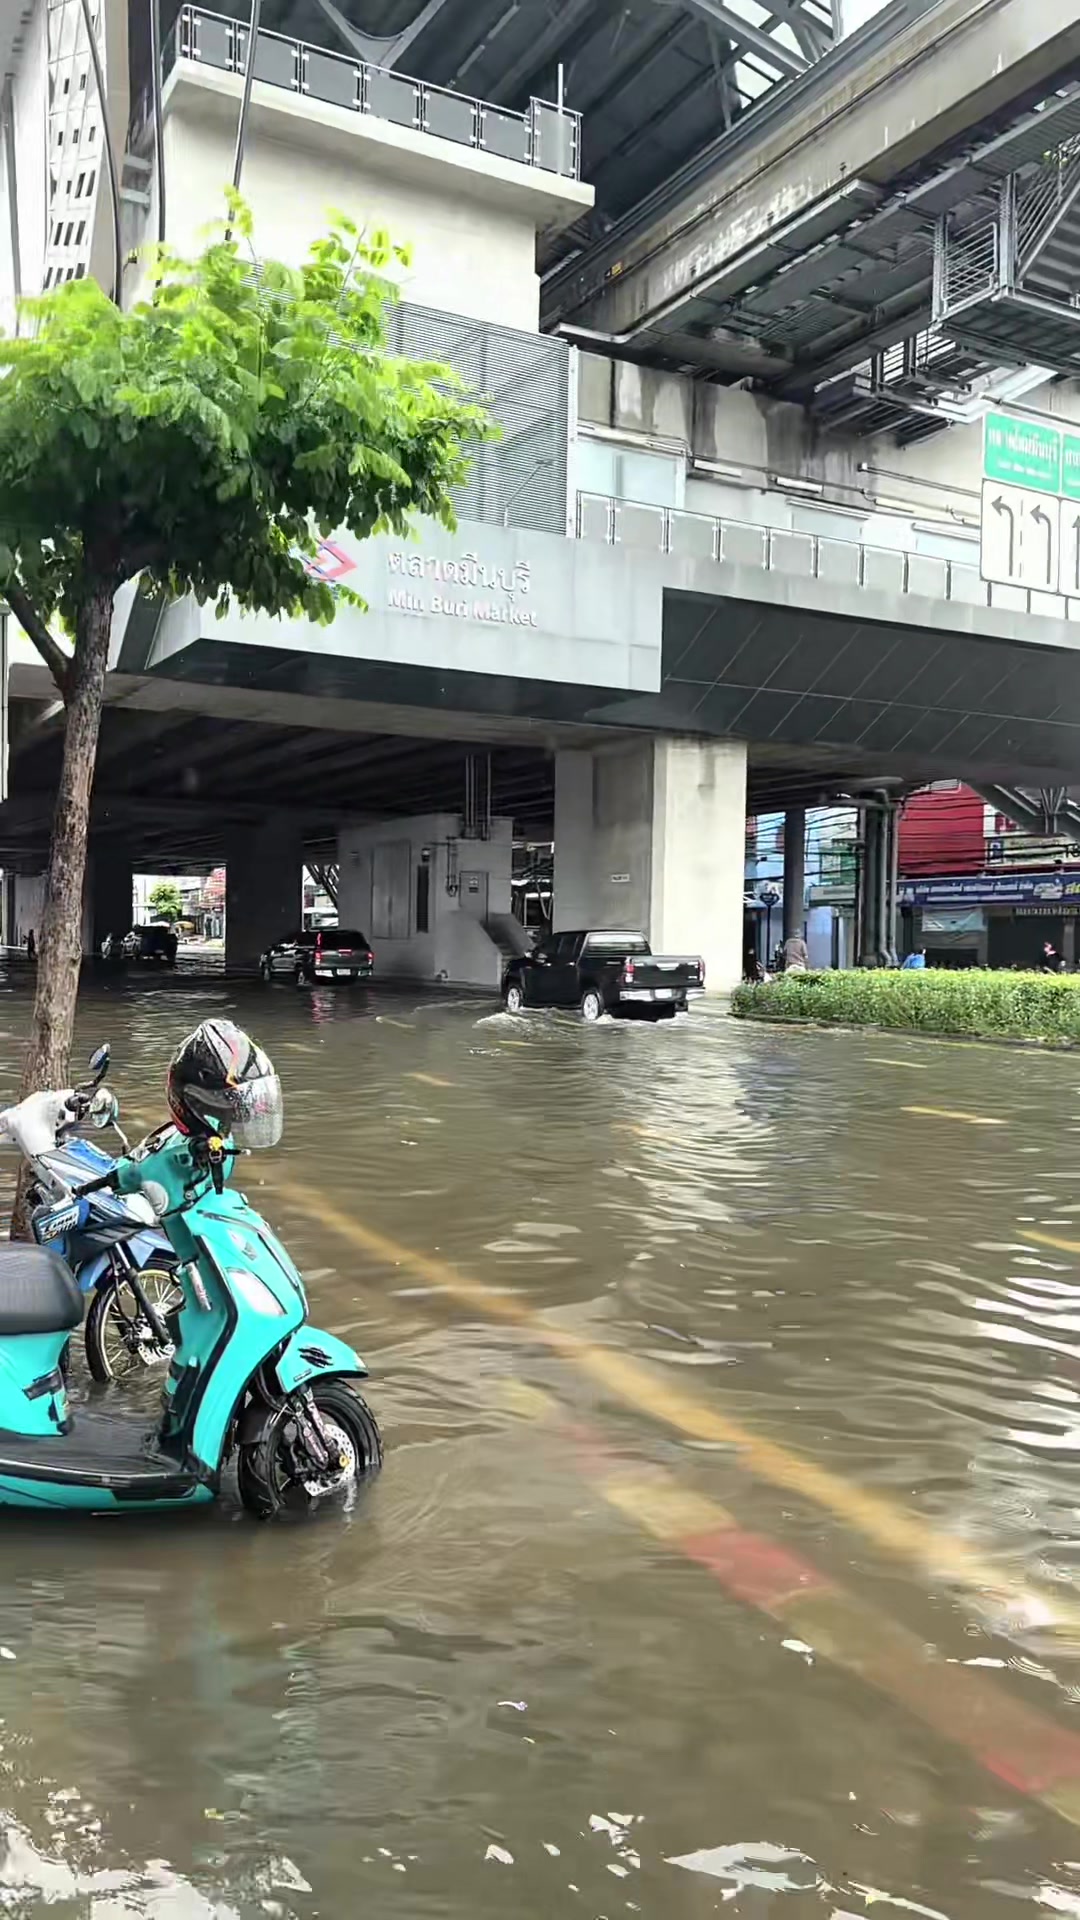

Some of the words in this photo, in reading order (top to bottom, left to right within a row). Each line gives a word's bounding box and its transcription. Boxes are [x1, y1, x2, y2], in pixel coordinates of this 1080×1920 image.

[388, 551, 531, 603] ตลาดมีนบุรี
[387, 589, 424, 612] Min
[430, 595, 468, 618] Buri
[472, 600, 538, 628] Market
